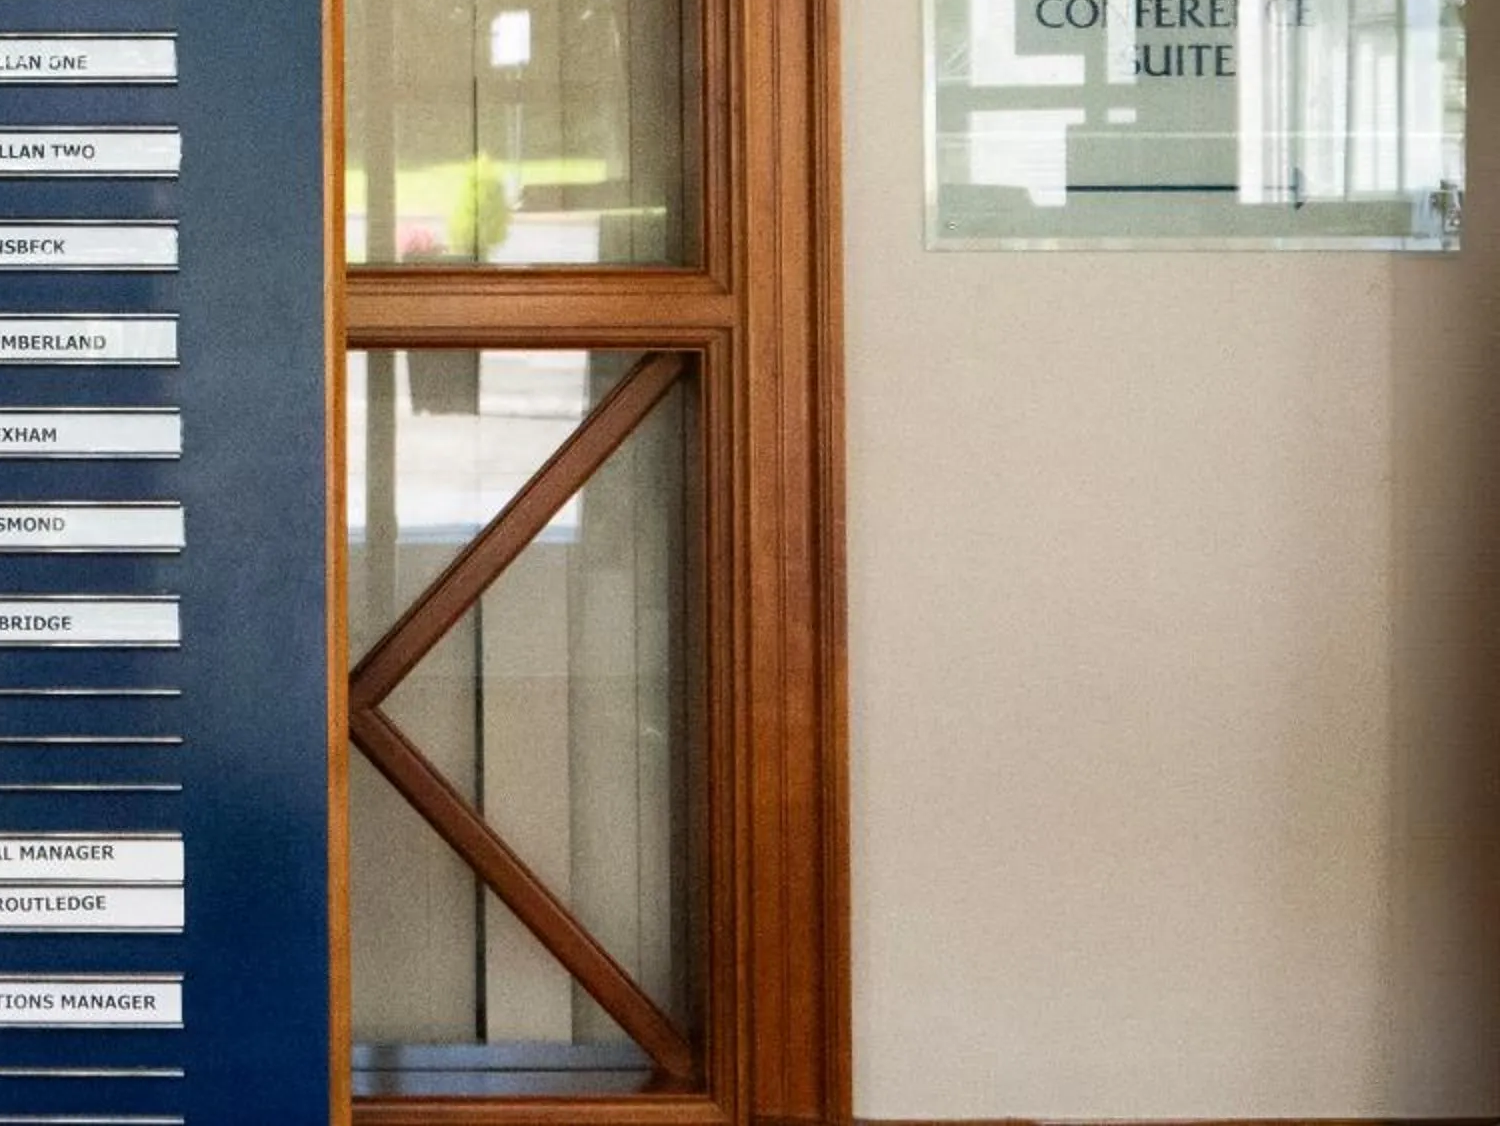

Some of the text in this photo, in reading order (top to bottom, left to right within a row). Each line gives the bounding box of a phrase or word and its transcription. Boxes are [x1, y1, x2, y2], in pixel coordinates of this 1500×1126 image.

[48, 55, 88, 72] ONE
[52, 143, 96, 160] TWO
[19, 843, 115, 862] MANAGER
[60, 993, 157, 1010] MANAGER
